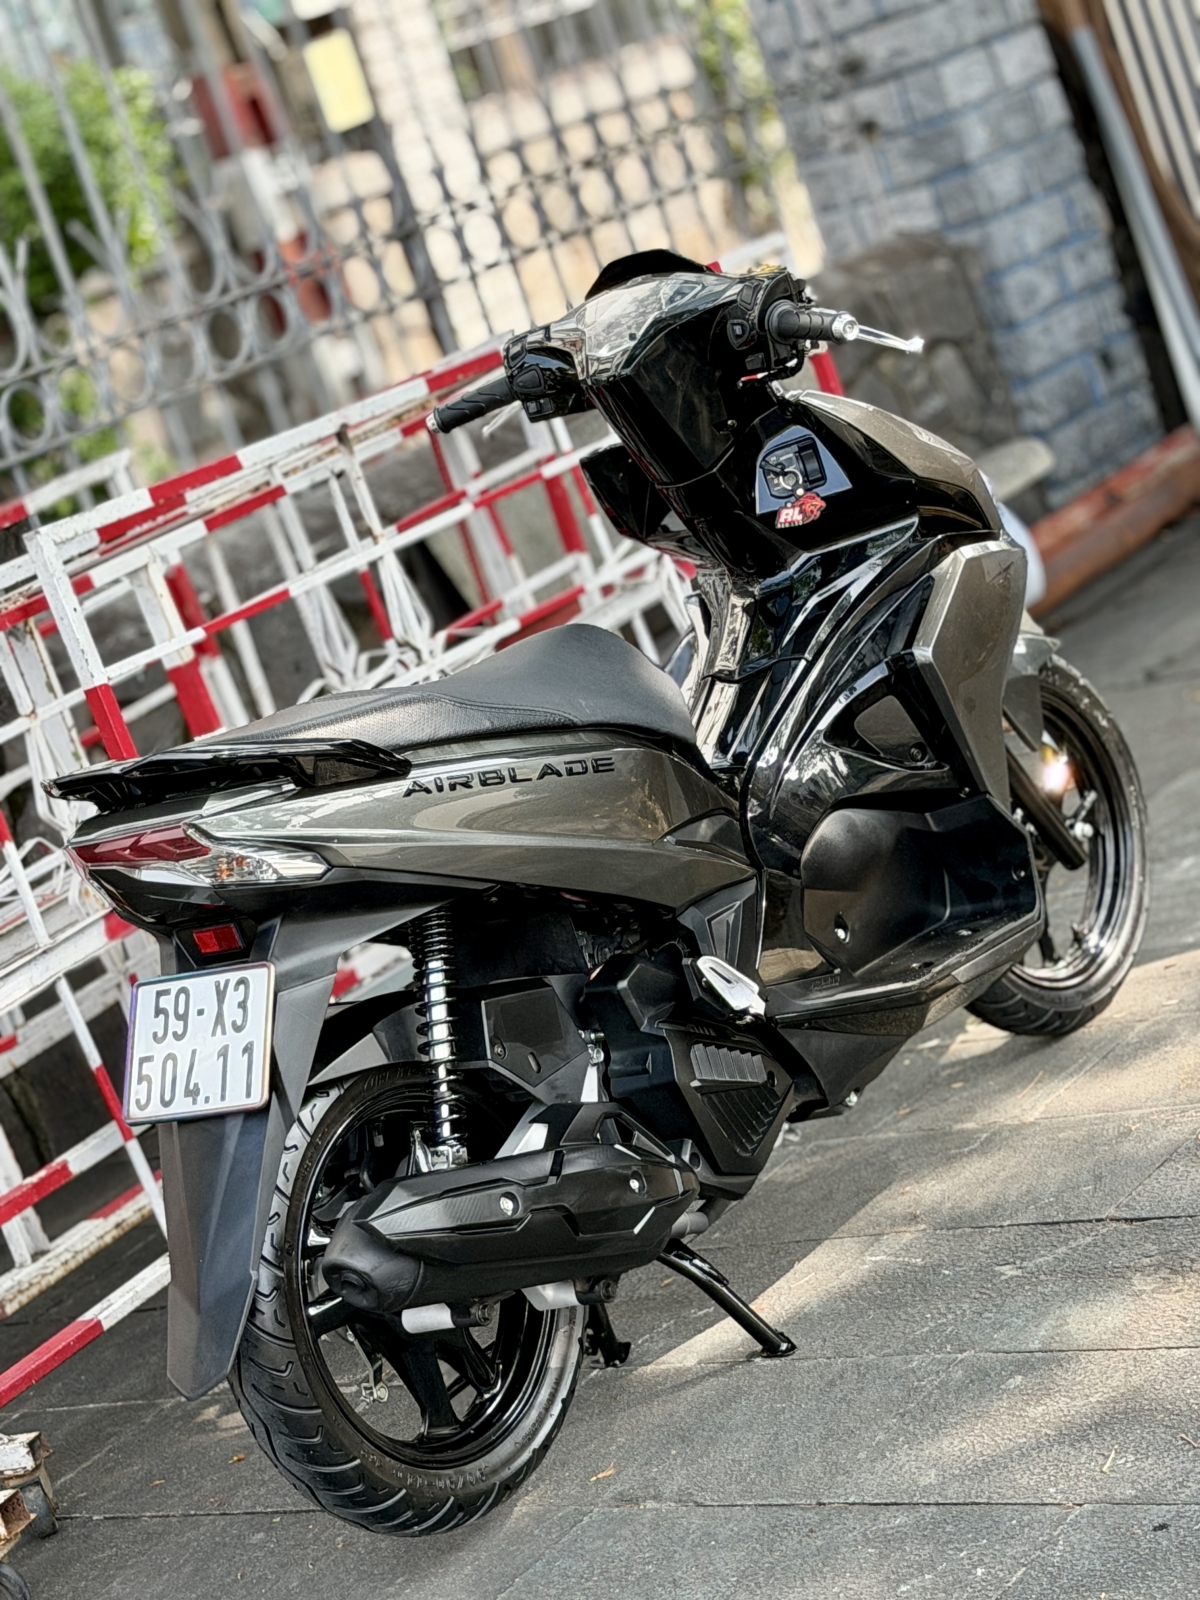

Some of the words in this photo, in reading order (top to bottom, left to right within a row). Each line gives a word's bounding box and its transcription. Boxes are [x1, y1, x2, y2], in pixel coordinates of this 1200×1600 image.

[402, 757, 615, 798] AIRBLADE
[152, 976, 250, 1044] 59-X3
[135, 1040, 255, 1111] 504.11
